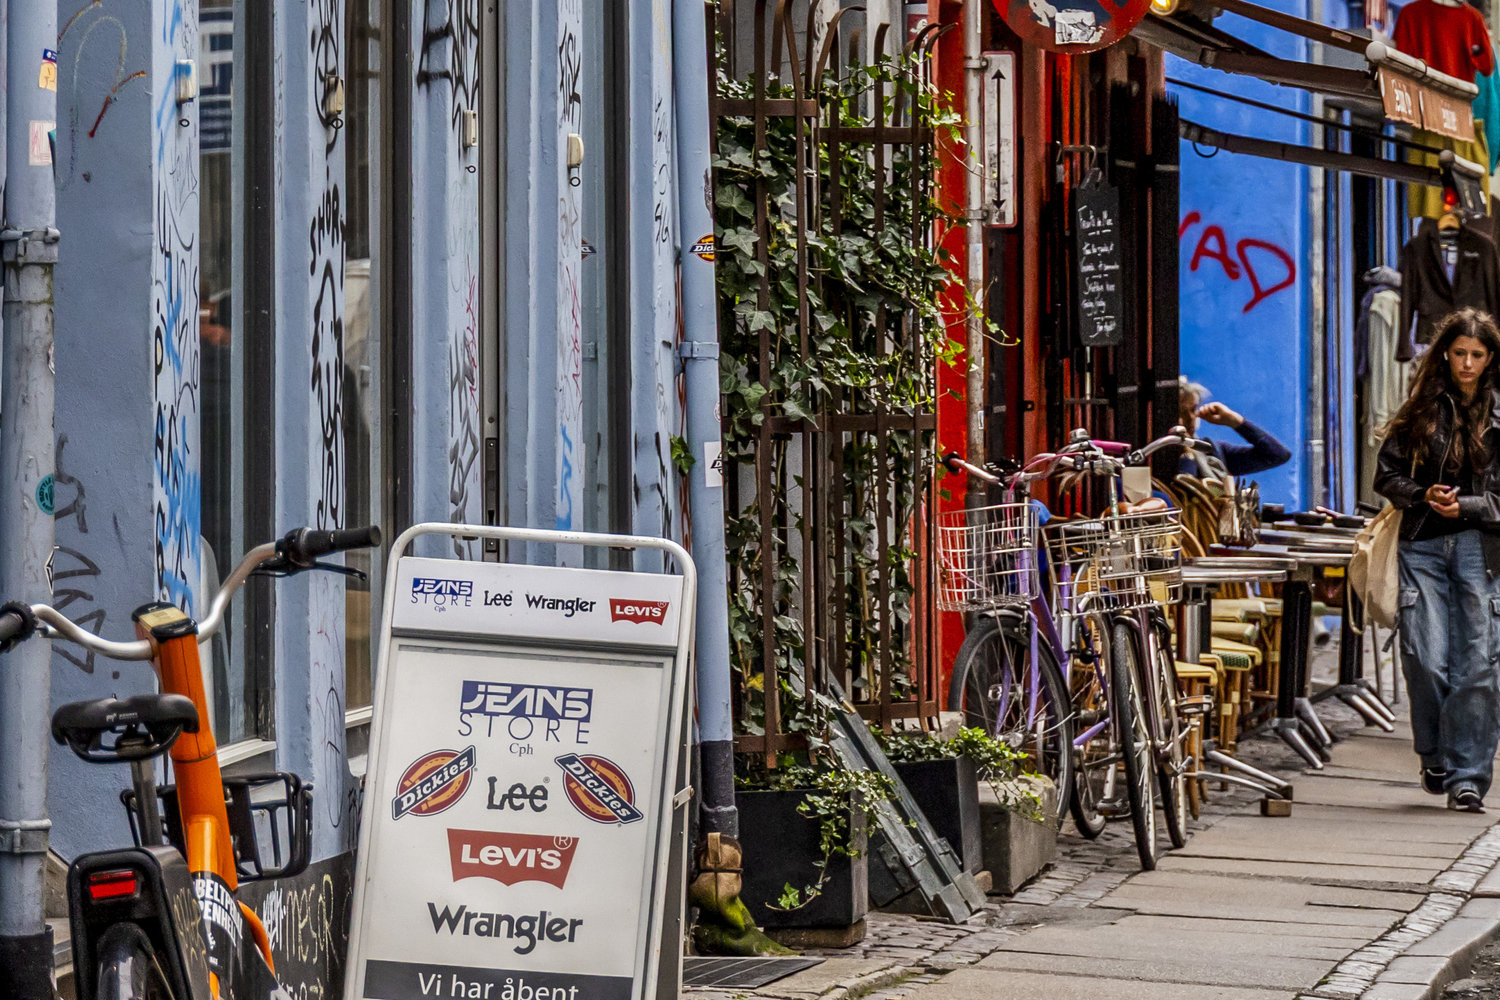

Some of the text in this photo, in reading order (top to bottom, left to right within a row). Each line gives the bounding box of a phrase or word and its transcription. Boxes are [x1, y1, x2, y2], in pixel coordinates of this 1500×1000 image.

[411, 593, 472, 607] STORE
[413, 579, 472, 595] JEANS
[484, 590, 512, 607] Lee
[525, 594, 596, 617] Wrangler
[462, 684, 589, 719] JEANS
[458, 713, 590, 744] STORE
[509, 743, 534, 755] Cph
[400, 755, 469, 812] Dickies
[487, 776, 548, 812] Lee
[565, 760, 631, 821] Dickies
[427, 902, 583, 955] Wrangler
[418, 972, 579, 1000] Vi har åbent
